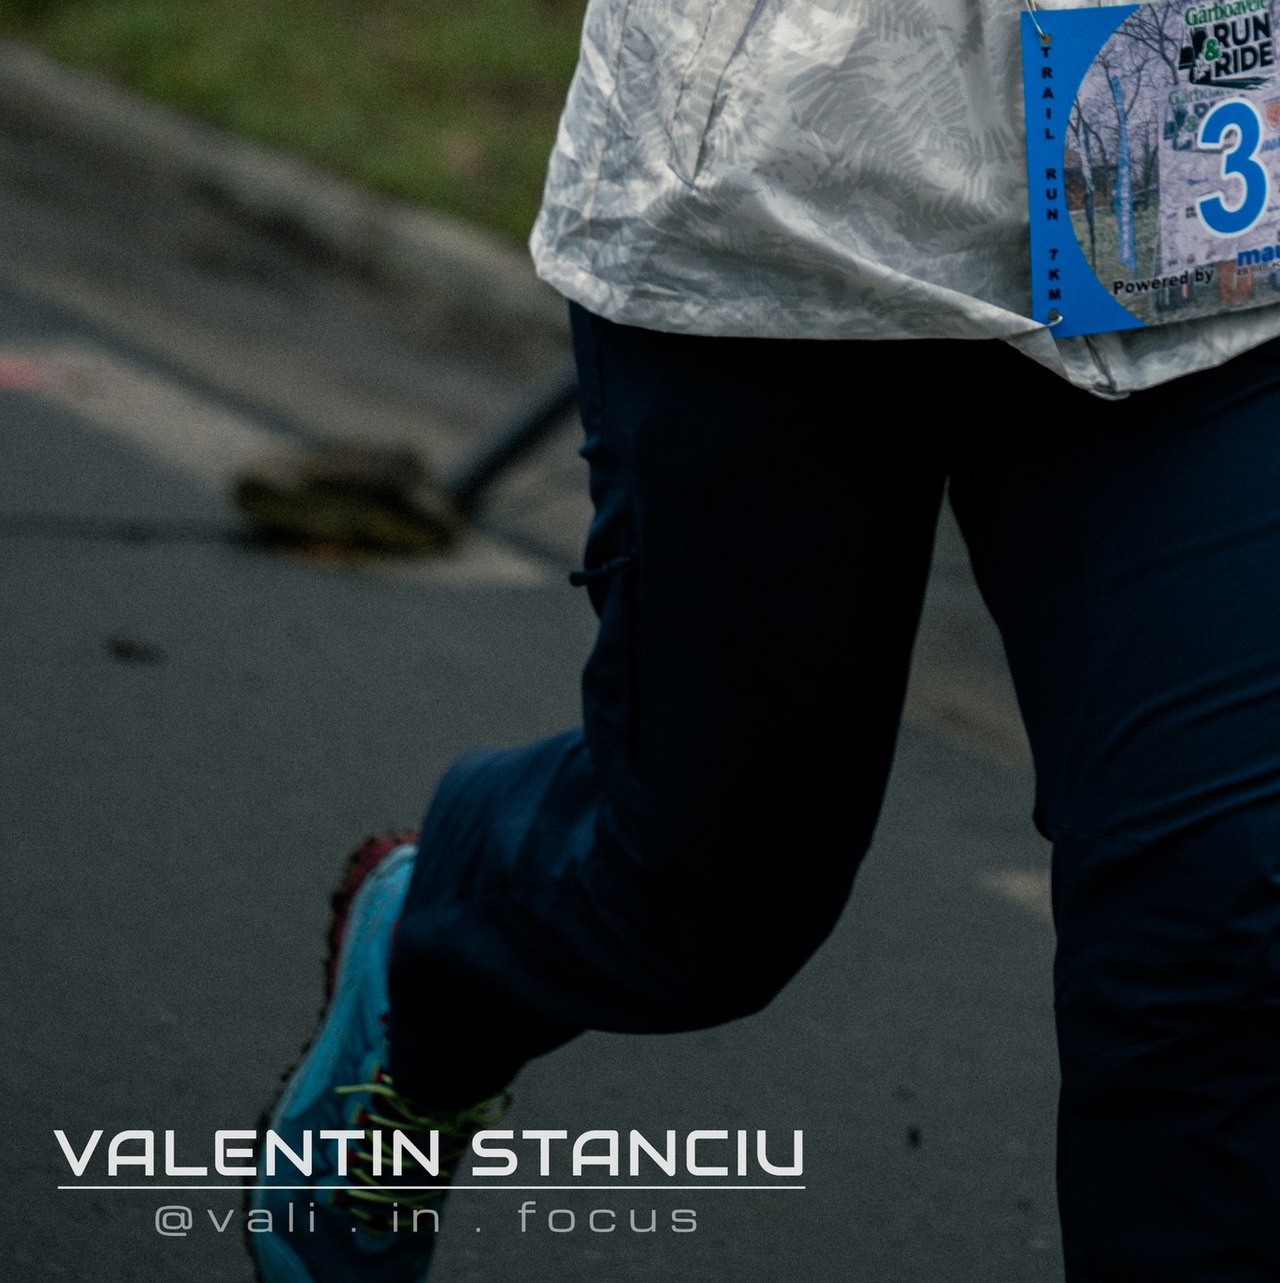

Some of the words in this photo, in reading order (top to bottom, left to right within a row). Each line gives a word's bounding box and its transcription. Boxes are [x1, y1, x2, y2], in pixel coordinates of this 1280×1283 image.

[1204, 38, 1219, 62] &
[1213, 11, 1272, 48] RUN
[1214, 40, 1275, 78] RIDE
[1040, 45, 1056, 141] TRAIL
[1200, 101, 1268, 235] 3
[1046, 167, 1059, 222] RUN
[1048, 248, 1062, 302] 7KM
[1113, 270, 1190, 296] Powered
[1194, 268, 1215, 285] by
